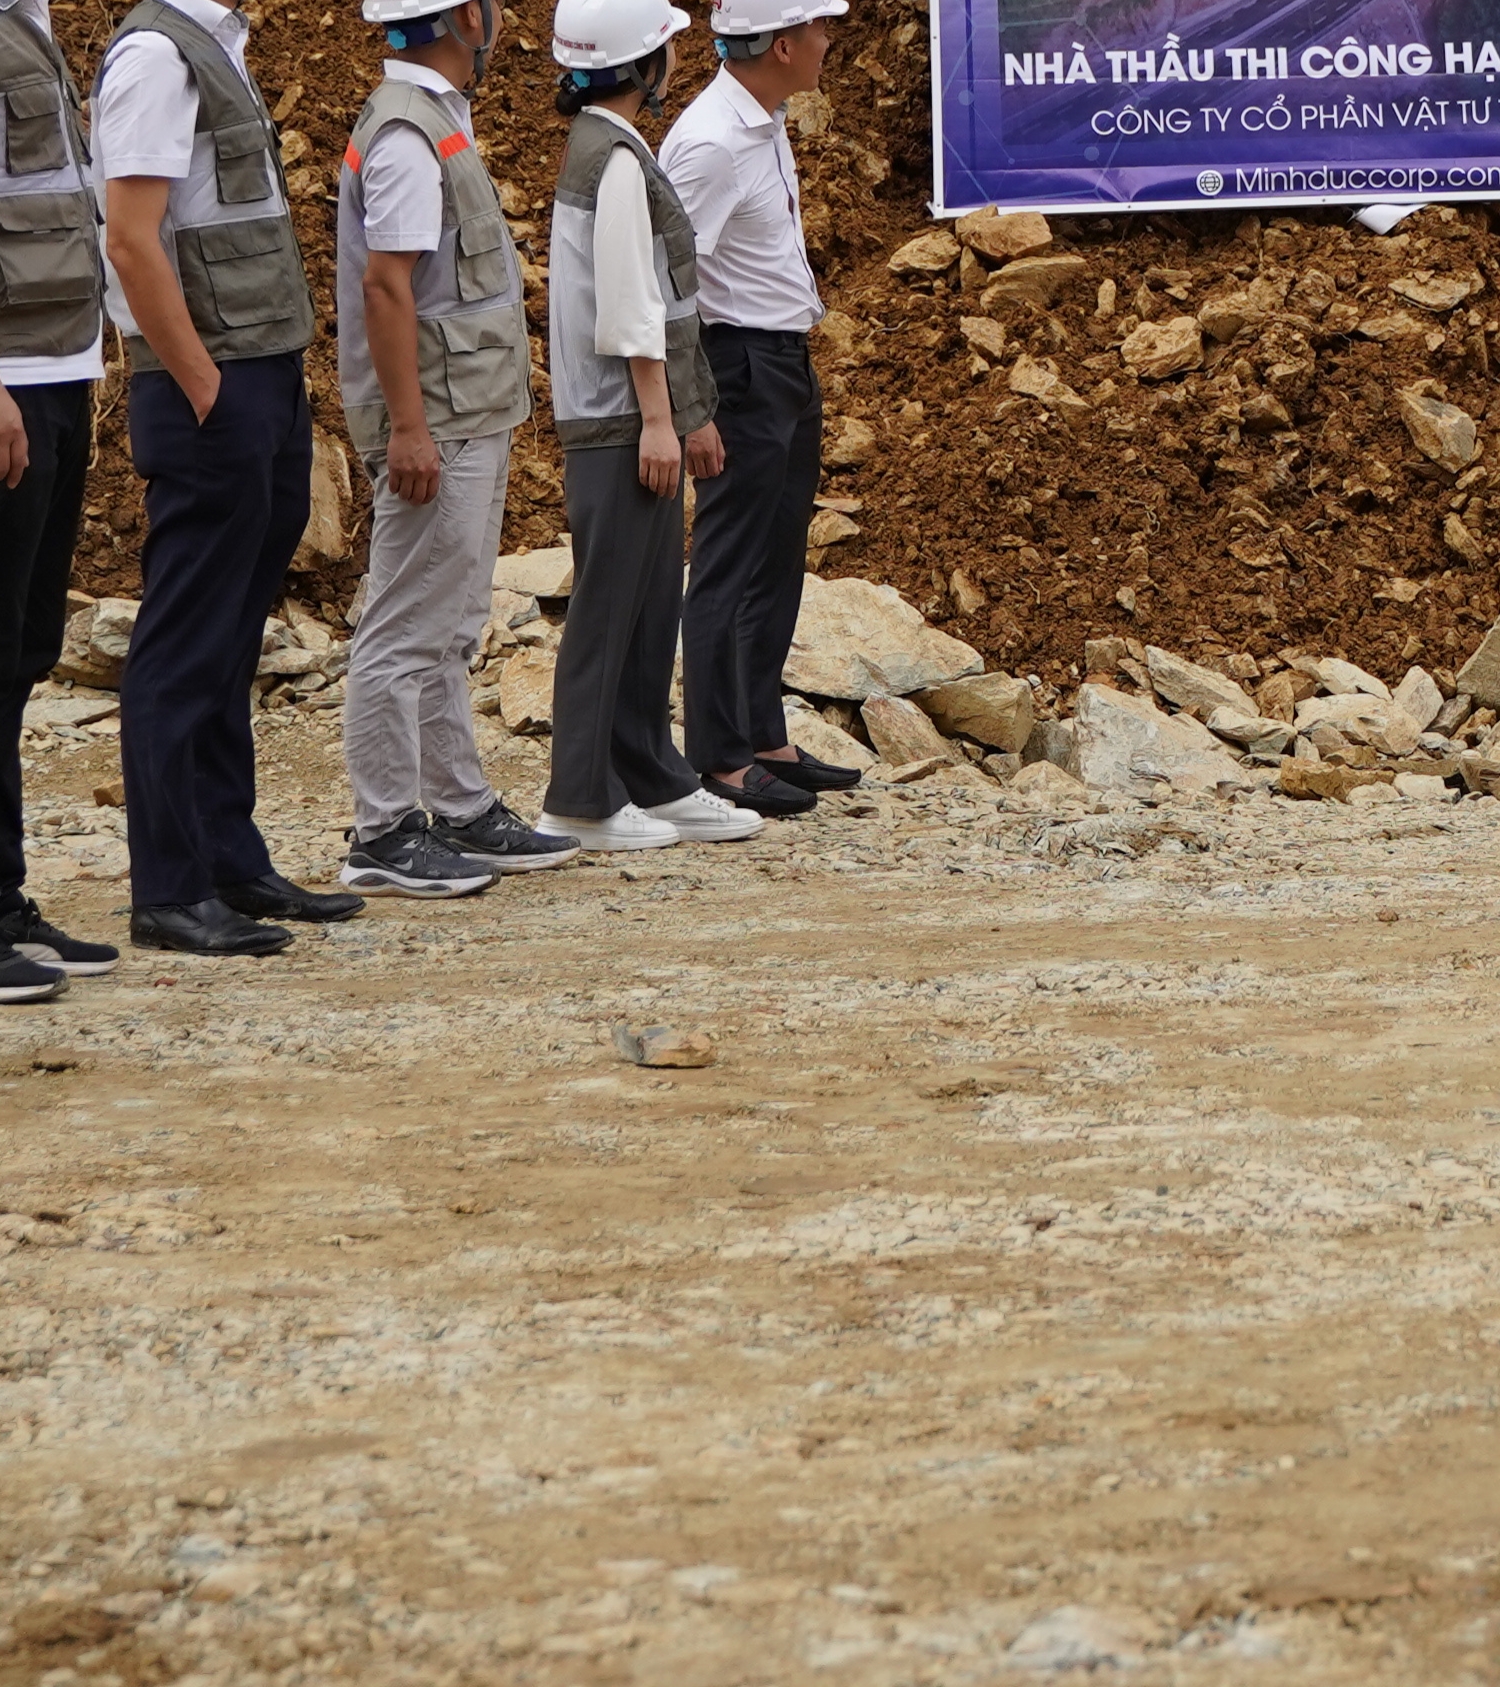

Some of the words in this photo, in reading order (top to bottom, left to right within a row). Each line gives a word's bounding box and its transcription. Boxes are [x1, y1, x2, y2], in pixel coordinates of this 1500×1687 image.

[1004, 41, 1096, 86] NHÀ
[1105, 32, 1215, 83] THẦU
[1226, 47, 1288, 81] THI
[1300, 36, 1433, 79] CÔNG
[1091, 105, 1191, 136] CÔNG
[1200, 108, 1232, 132] TY
[1241, 93, 1292, 131] CỔ
[1302, 95, 1384, 130] PHẦN
[1392, 96, 1449, 132] VẬT
[1458, 97, 1493, 126] TƯ
